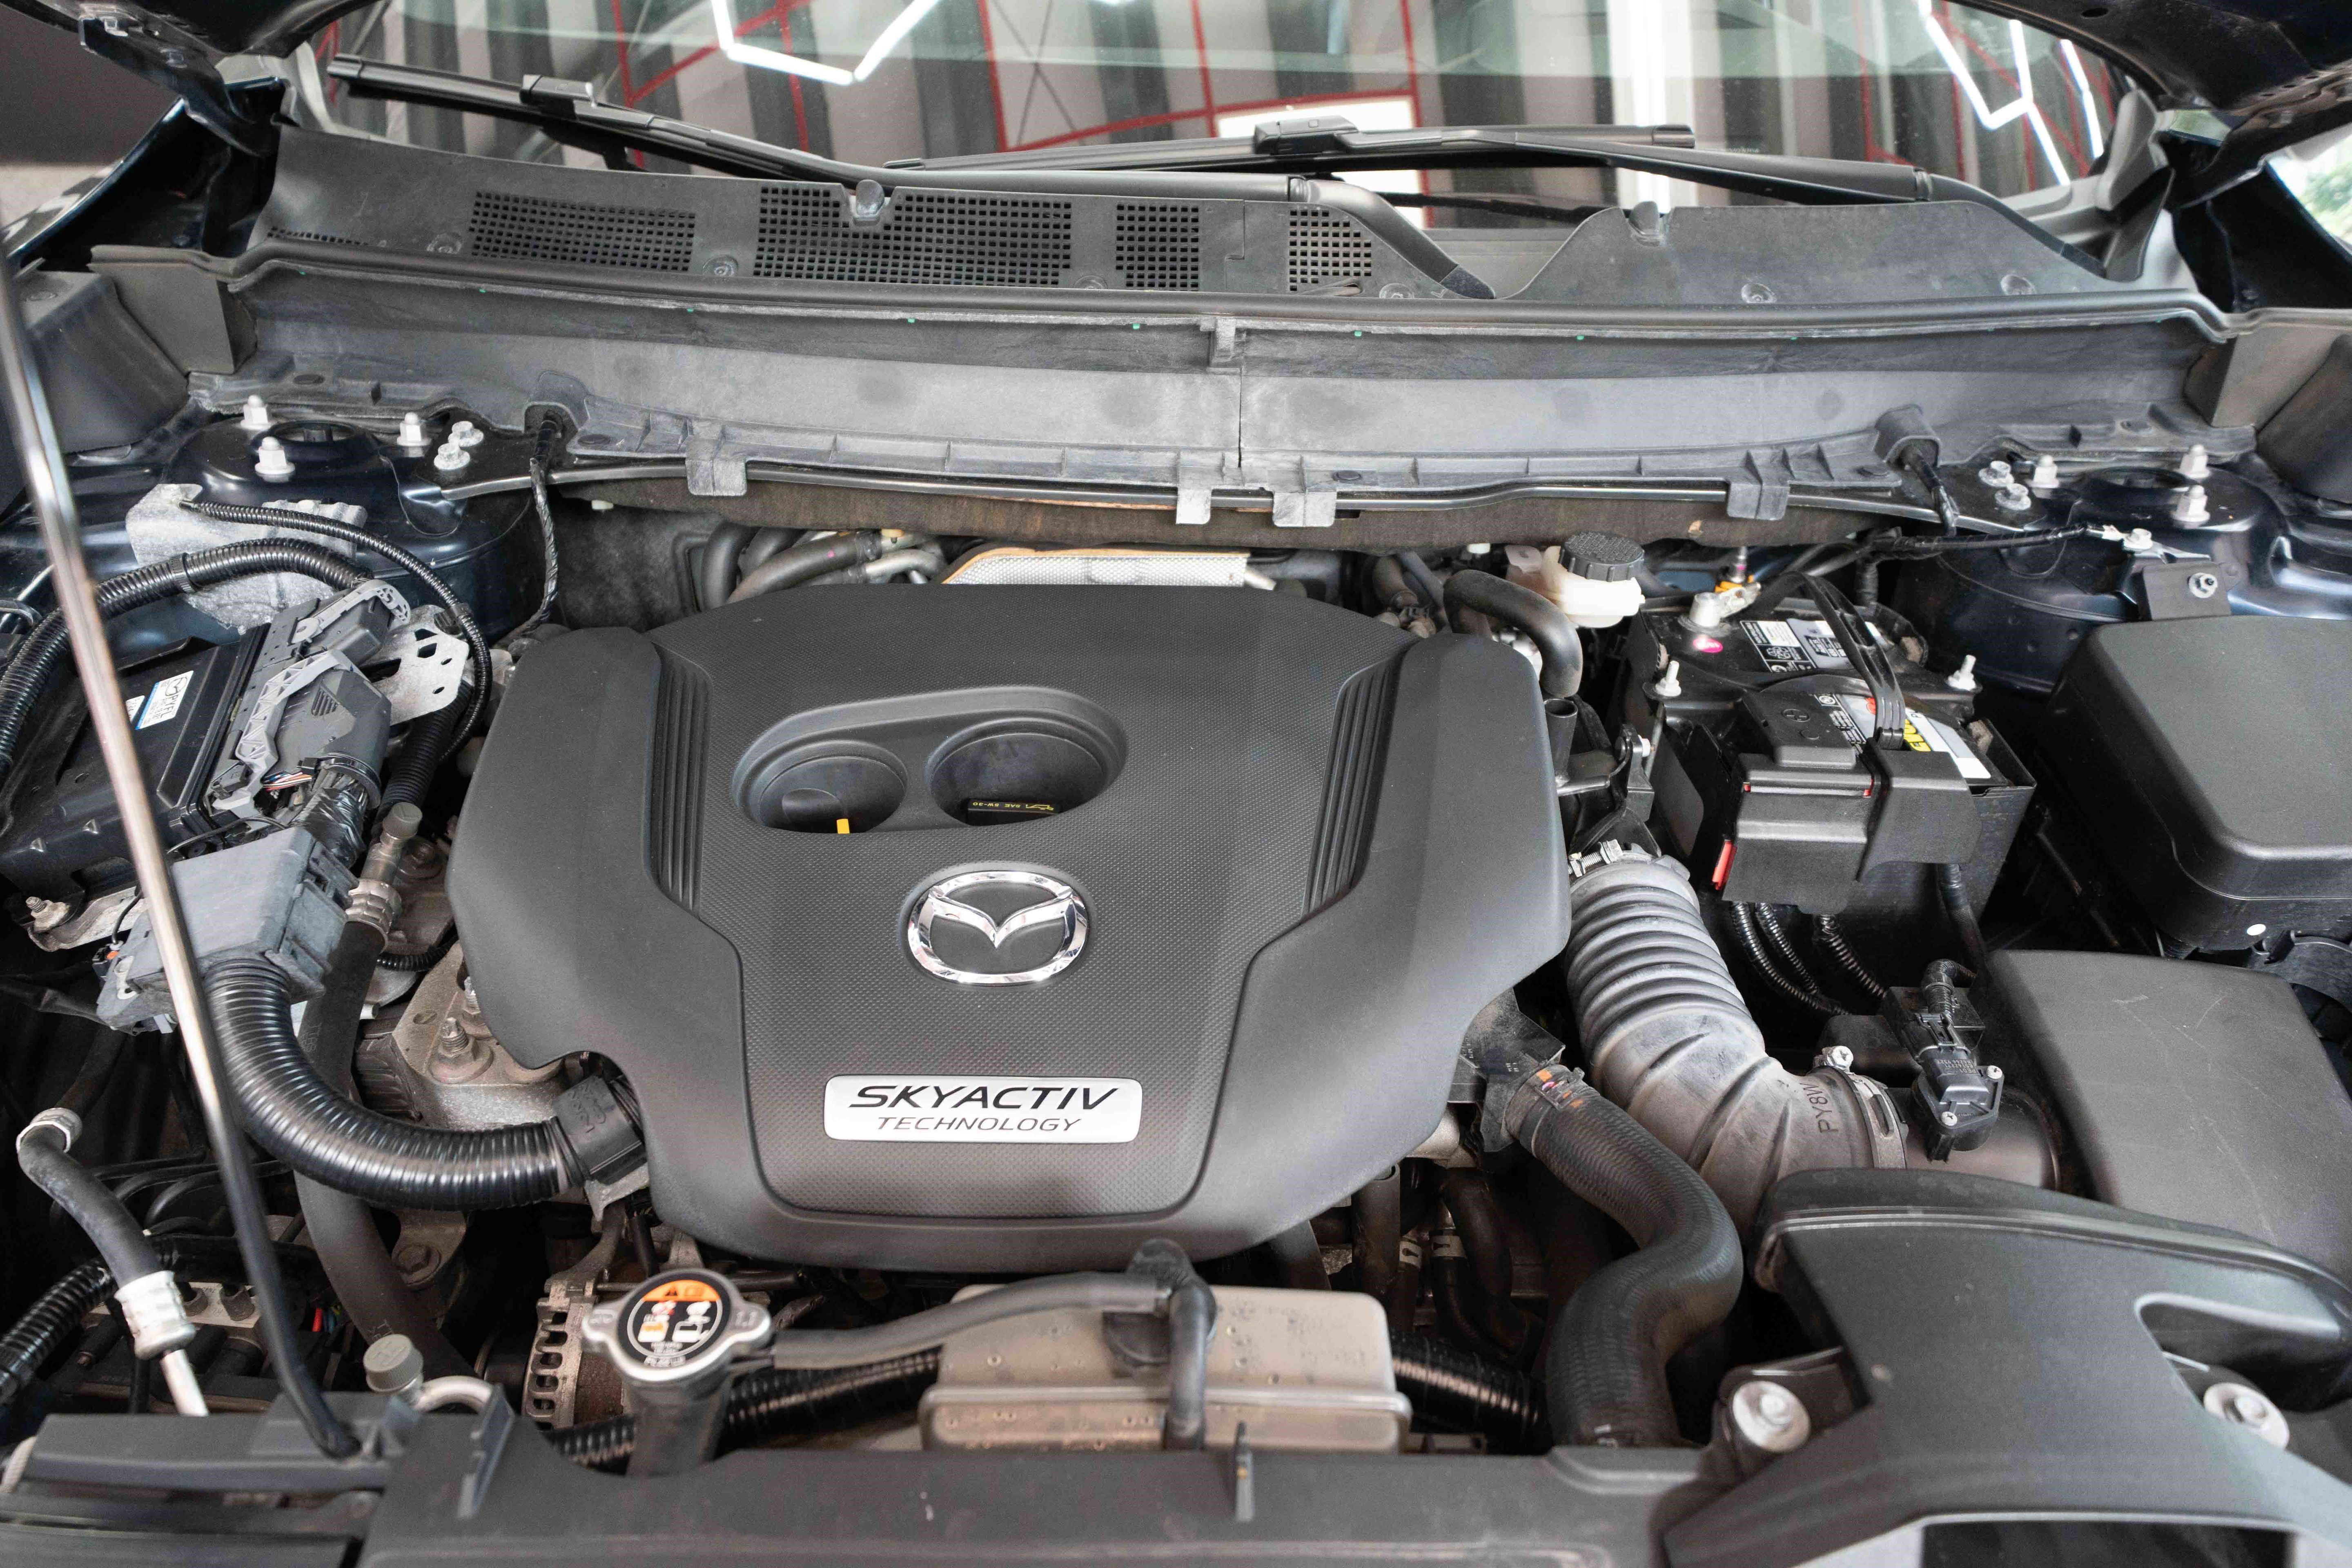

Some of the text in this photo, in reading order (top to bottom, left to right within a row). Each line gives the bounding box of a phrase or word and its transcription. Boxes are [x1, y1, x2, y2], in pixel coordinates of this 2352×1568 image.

[160, 695, 179, 718] PYFL
[848, 1085, 1120, 1110] SKYACTIV
[1799, 1082, 1839, 1133] PY8W
[877, 1116, 1082, 1132] TECHNOLOGY
